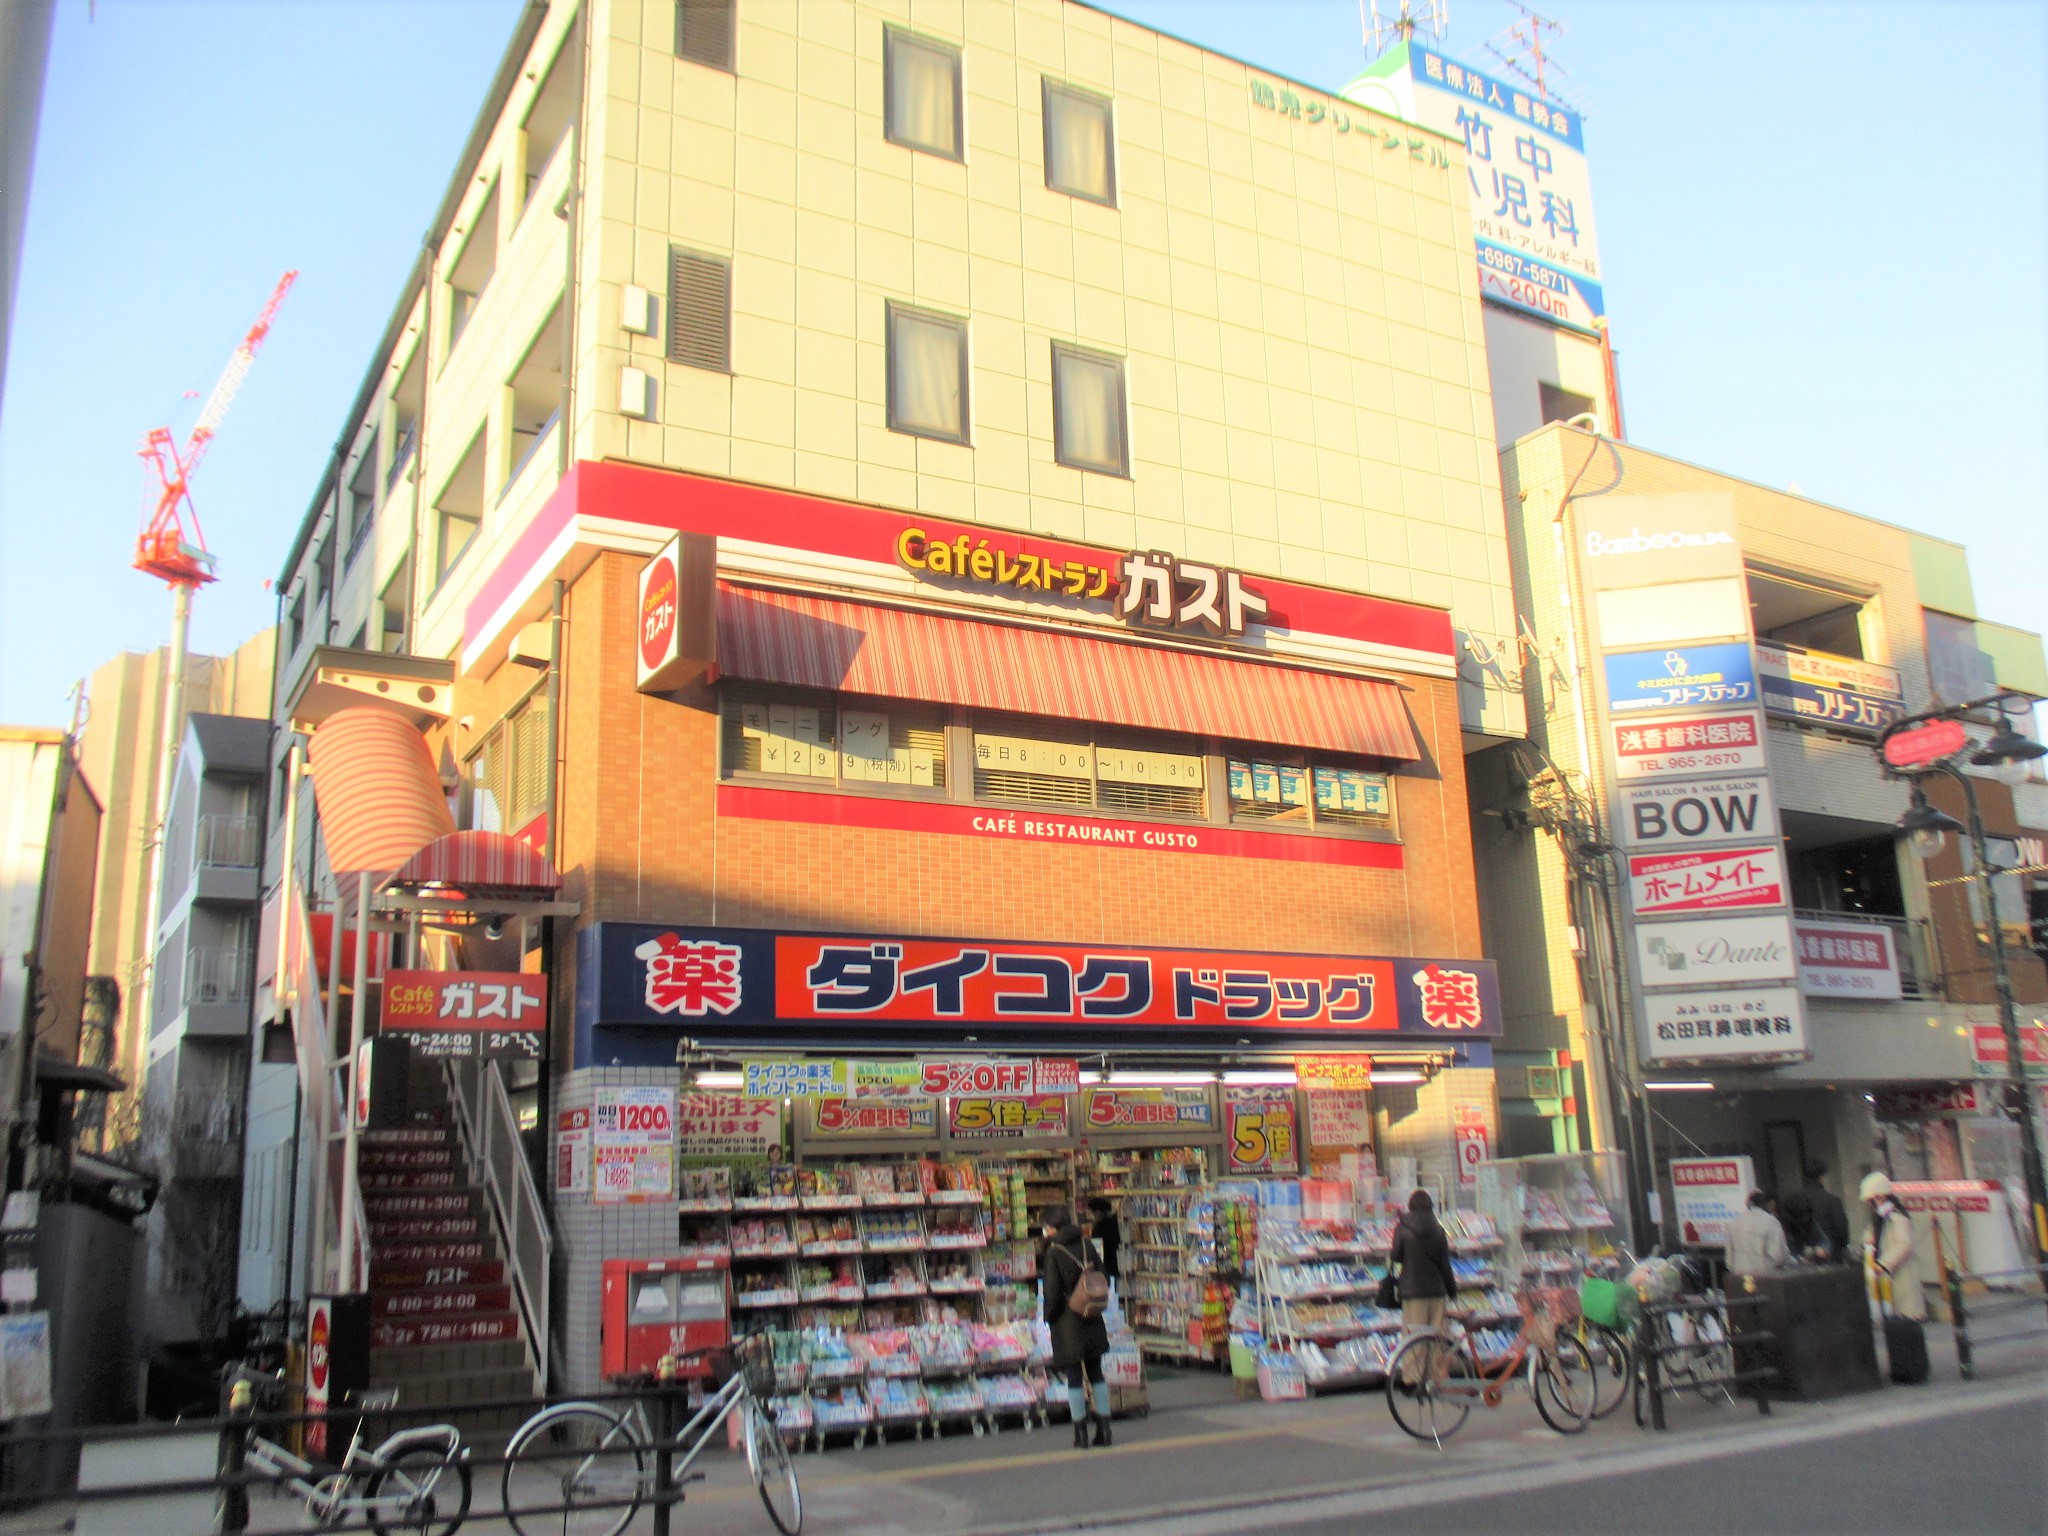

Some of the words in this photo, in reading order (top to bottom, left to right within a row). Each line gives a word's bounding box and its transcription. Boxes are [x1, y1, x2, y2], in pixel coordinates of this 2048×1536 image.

[1455, 104, 1552, 182] 竹中
[1122, 552, 1268, 634] ガスト
[644, 600, 674, 645] ガスト
[1661, 682, 1753, 706] フリーステップ
[747, 713, 882, 738] モーニング
[1620, 722, 1752, 751] 浅香歯科医院
[1638, 760, 1664, 771] TEL
[1631, 790, 1653, 798] HAIR
[1655, 787, 1687, 796] SALON
[1703, 784, 1724, 792] NAIL
[1726, 781, 1759, 790] SALON
[972, 812, 1017, 834] CAFÉ
[1024, 820, 1136, 843] RESTAURANT
[1143, 831, 1198, 848] GUSTO
[1633, 794, 1759, 839] BOW
[1644, 860, 1765, 901] ホームメイト
[1691, 936, 1787, 964] Dante
[637, 932, 743, 1016] 薬
[806, 943, 1153, 1018] ダイコク
[1172, 968, 1376, 1024] ドラッグ
[390, 985, 434, 1002] Café
[390, 1002, 433, 1014] レストラン
[439, 982, 540, 1019] ガスト
[1413, 963, 1483, 1029] 薬
[748, 1064, 832, 1079] ダイコクの楽天
[922, 1062, 1032, 1094] 5%OFF
[748, 1079, 845, 1096] ポイントカードなら
[953, 1098, 1062, 1129] 5倍デー
[1180, 1107, 1207, 1120] SALE
[1232, 1113, 1293, 1164] 5倍
